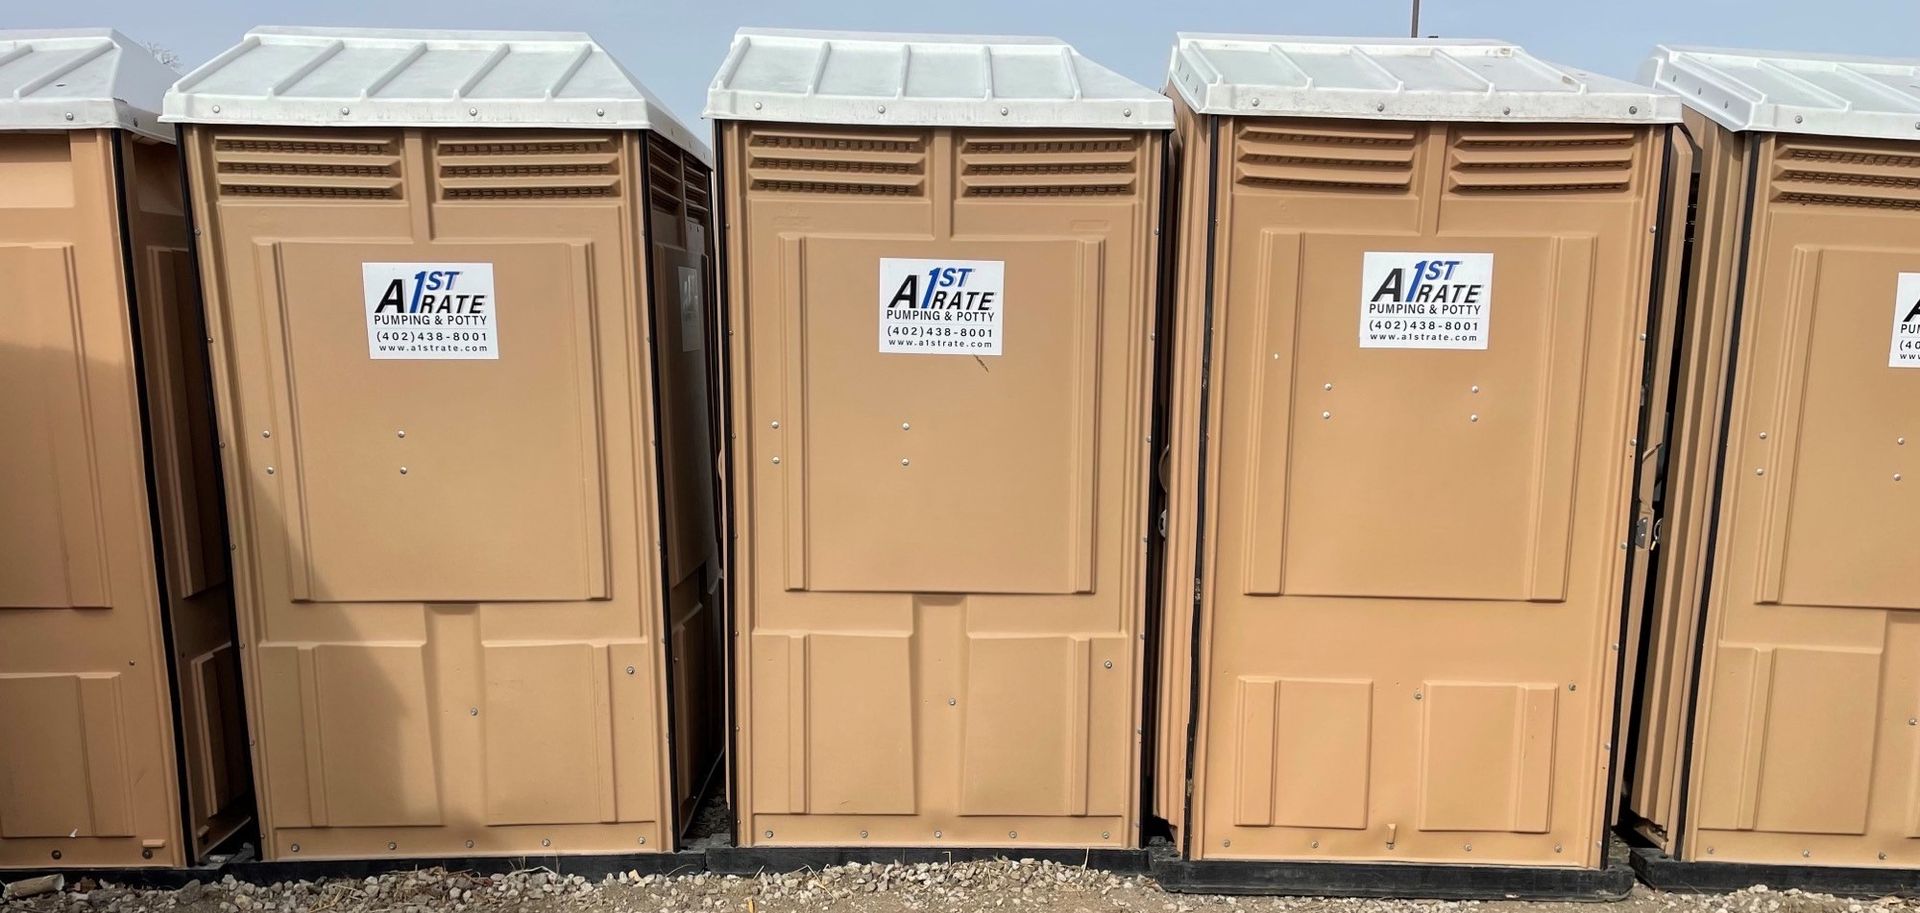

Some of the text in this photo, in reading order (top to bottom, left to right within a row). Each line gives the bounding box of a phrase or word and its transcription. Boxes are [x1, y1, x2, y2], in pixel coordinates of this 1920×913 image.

[1415, 284, 1483, 304] RATE
[419, 294, 487, 314] RATE
[930, 290, 996, 311] RATE
[886, 309, 995, 322] PUMPING & POTTY
[1369, 304, 1481, 315] PUMPING & POTTY
[374, 315, 487, 326] PUMPING & POTTY
[1369, 320, 1478, 332] (402)438-8001
[376, 331, 487, 343] (402)438-8001
[887, 325, 993, 338] (402)438-8001
[1370, 333, 1477, 342] www.a1strate.com
[379, 344, 488, 352] www.a1strate.com
[888, 339, 993, 348] www.a1strate.com
